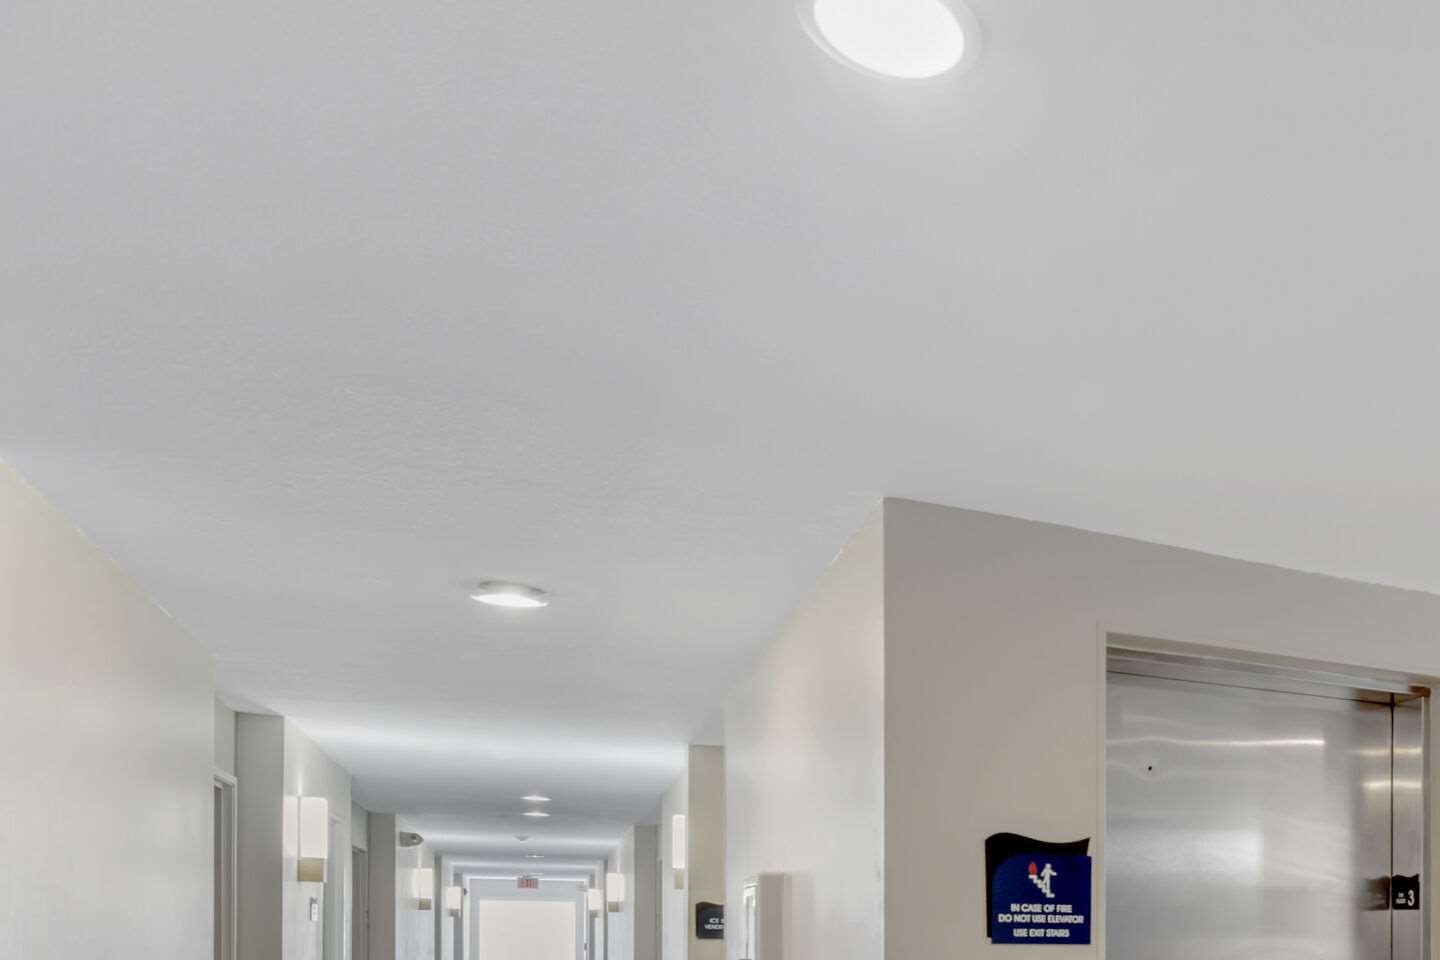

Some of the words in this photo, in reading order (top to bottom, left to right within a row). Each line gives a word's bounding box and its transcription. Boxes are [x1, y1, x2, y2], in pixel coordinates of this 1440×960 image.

[1408, 889, 1414, 906] 3
[1010, 903, 1020, 912] IN
[1021, 903, 1042, 913] CASE
[1043, 904, 1055, 913] OF
[1056, 904, 1072, 913] FIRE
[998, 913, 1012, 923] DO
[1014, 913, 1031, 923] NOT
[1032, 914, 1046, 923] USE
[1047, 914, 1084, 923] ELEVATOR
[1013, 928, 1028, 937] USE
[1029, 928, 1045, 937] EXIT
[1046, 928, 1070, 937] STAIRS
